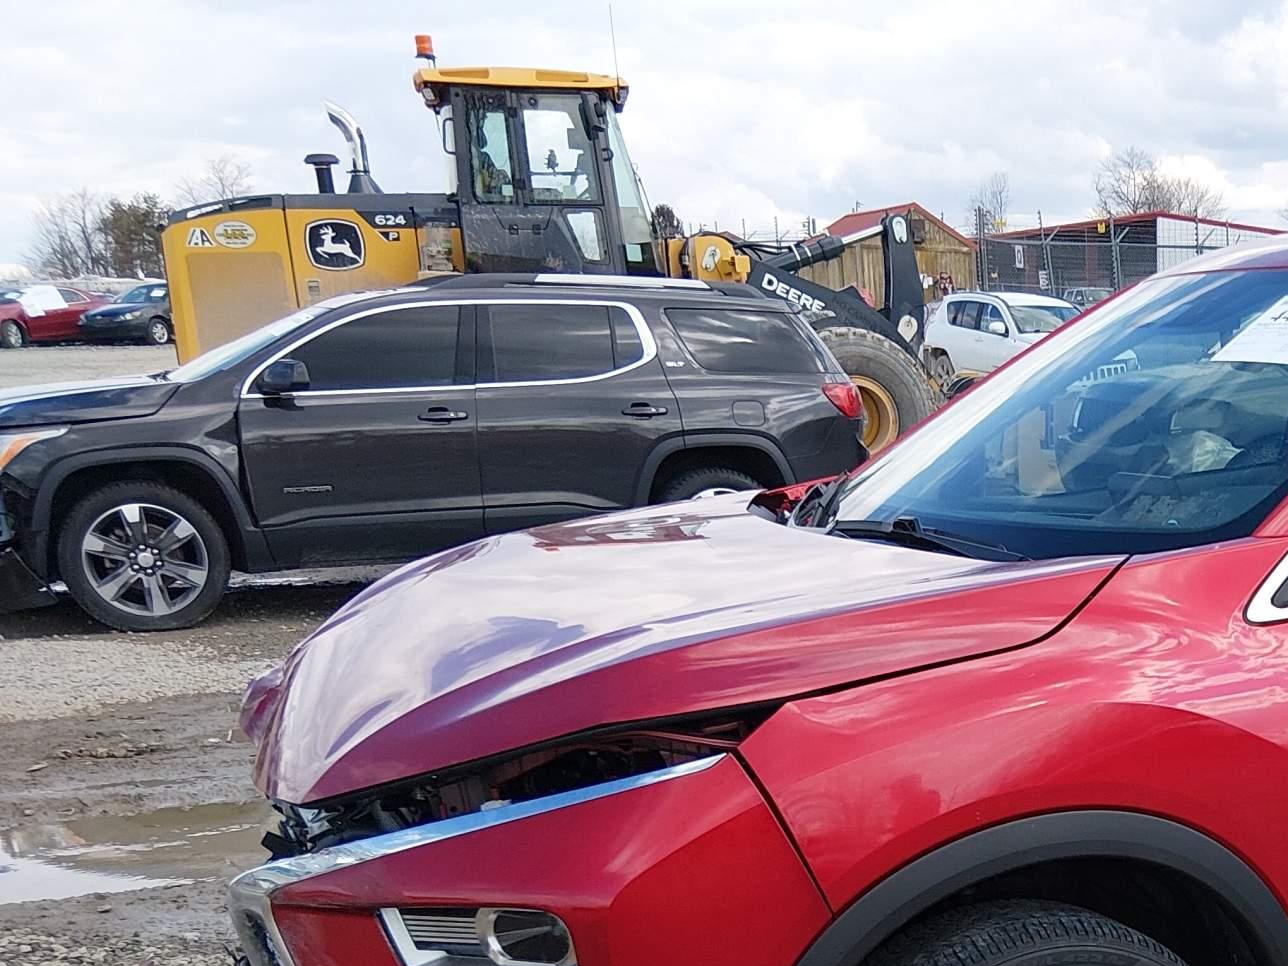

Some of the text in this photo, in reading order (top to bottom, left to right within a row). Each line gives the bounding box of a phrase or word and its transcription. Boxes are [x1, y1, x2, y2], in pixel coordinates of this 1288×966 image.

[374, 214, 407, 226] 624
[388, 231, 399, 241] P
[761, 272, 826, 312] DEERE
